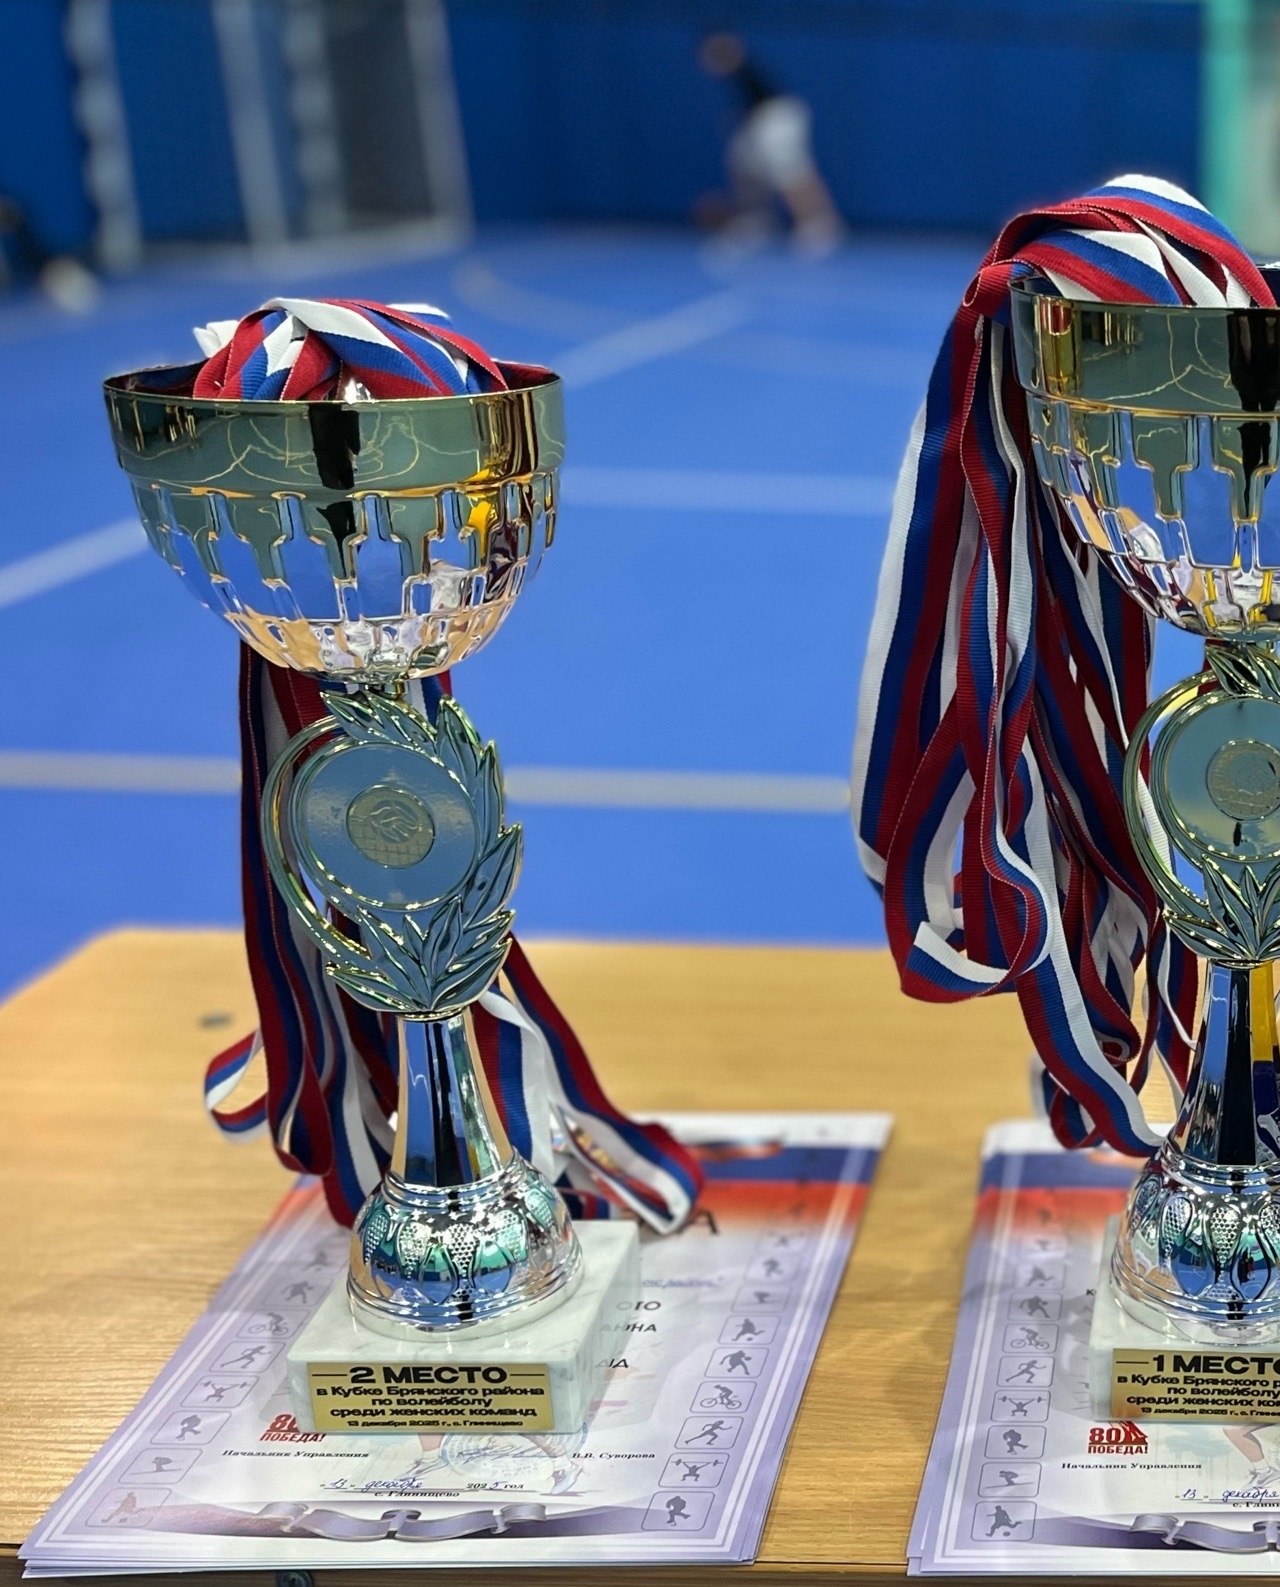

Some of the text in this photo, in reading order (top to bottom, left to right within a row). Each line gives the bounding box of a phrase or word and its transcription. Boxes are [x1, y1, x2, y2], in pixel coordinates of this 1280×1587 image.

[1153, 1354, 1164, 1372] 1
[349, 1366, 507, 1384] 2 МЕСТО
[1117, 1375, 1128, 1383] в
[1131, 1374, 1180, 1386] Кубке
[1183, 1375, 1270, 1389] Брянского
[316, 1386, 544, 1398] в Кубке Брянского района
[1167, 1386, 1280, 1399] по волейболу
[371, 1396, 493, 1408] по волейболу
[1126, 1396, 1179, 1407] среди
[1182, 1397, 1254, 1407] женских
[330, 1408, 537, 1419] среди женских команд
[260, 1433, 327, 1442] ПОБЕДА!
[1088, 1427, 1121, 1444] 80
[294, 1450, 370, 1458] Управления
[1088, 1444, 1148, 1455] ПОБЕДА!
[1130, 1462, 1202, 1470] Управления
